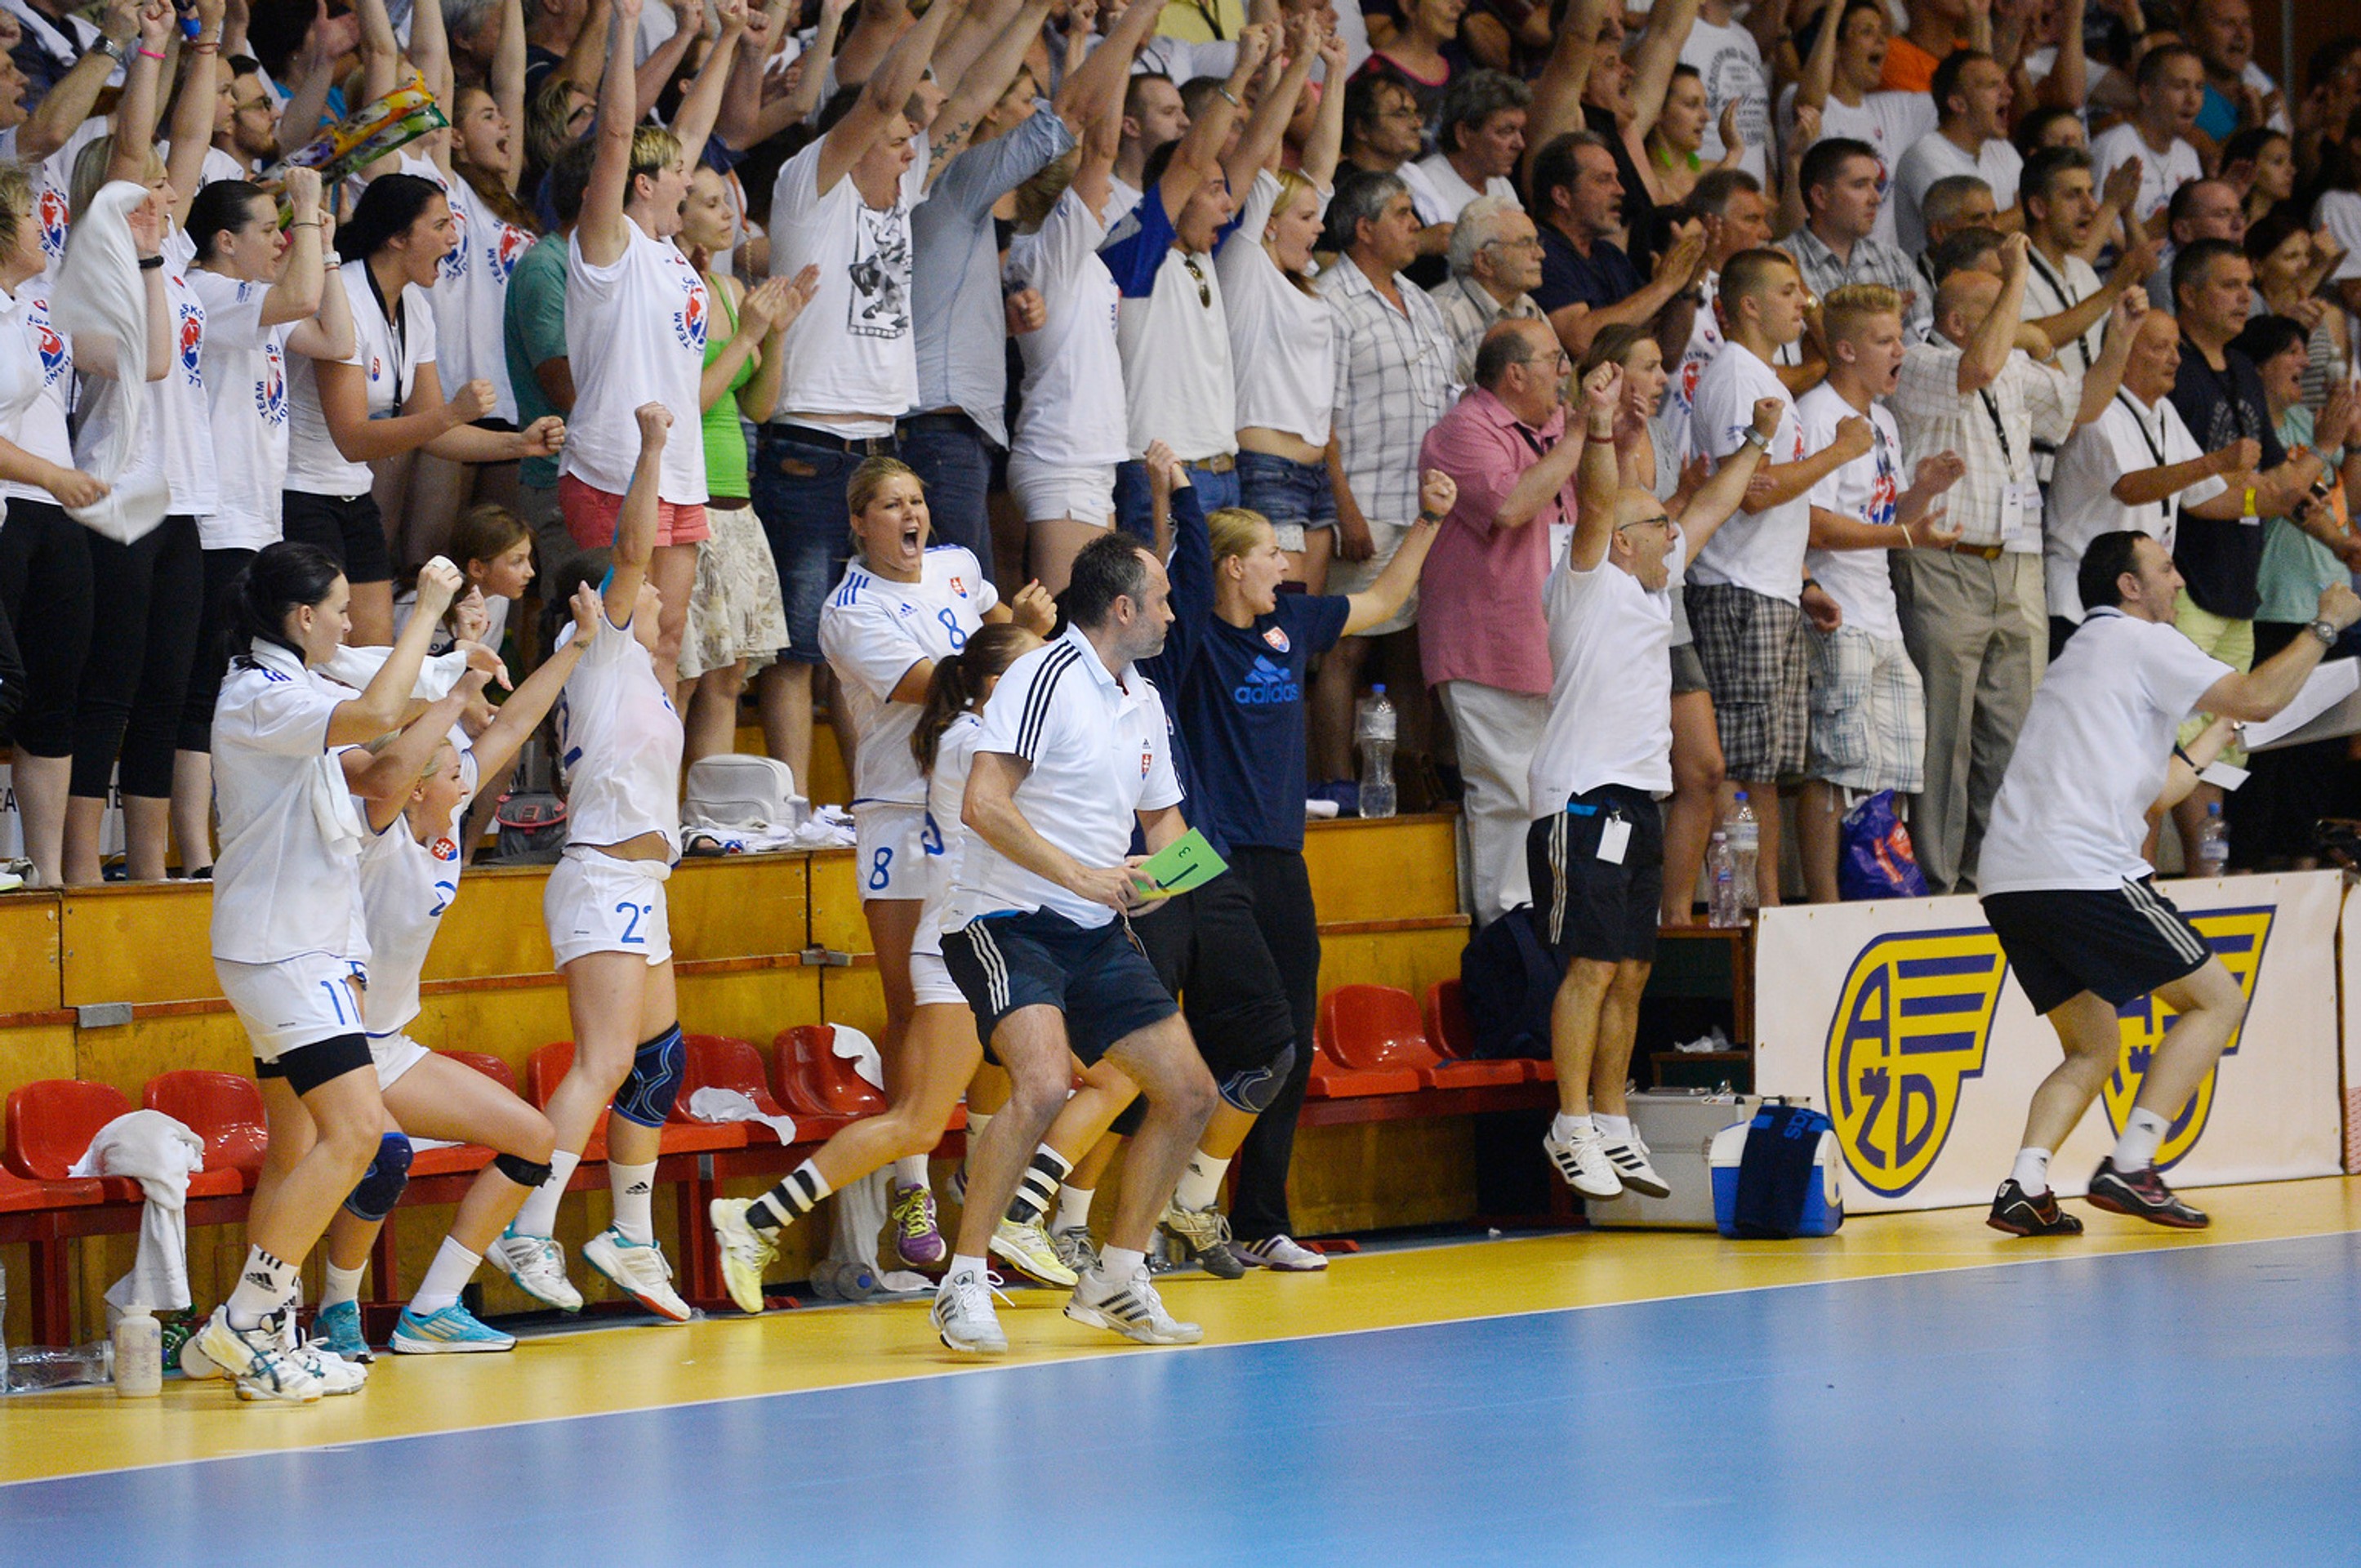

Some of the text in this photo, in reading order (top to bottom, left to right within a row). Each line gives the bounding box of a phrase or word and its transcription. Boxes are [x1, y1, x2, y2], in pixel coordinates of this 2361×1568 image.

[674, 312, 691, 350] TEAM
[255, 381, 269, 419] TEAM
[938, 607, 968, 650] 8
[1234, 683, 1299, 704] adidas
[869, 846, 893, 891] 8
[319, 978, 360, 1027] 11
